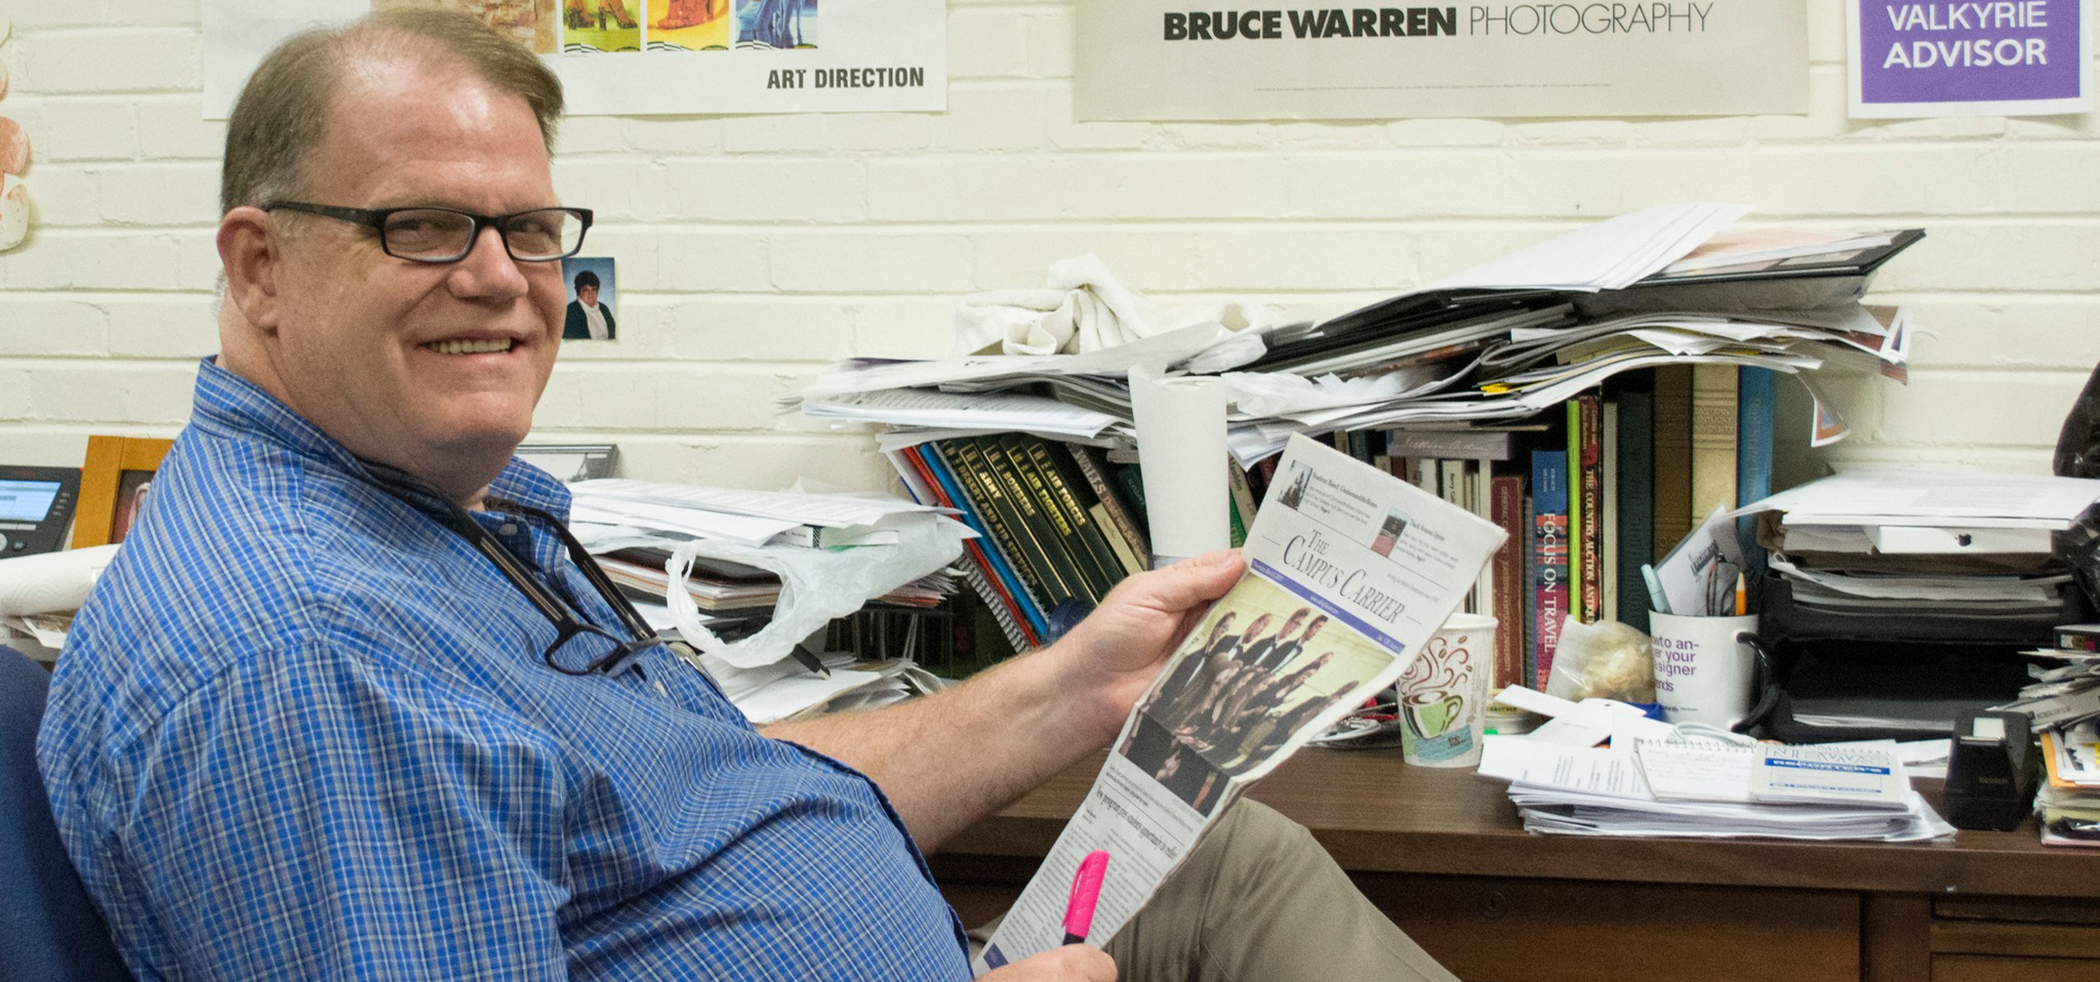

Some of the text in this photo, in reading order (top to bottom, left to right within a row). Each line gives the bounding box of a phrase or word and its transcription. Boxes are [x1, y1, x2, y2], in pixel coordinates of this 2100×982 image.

[1163, 2, 1714, 41] BRUCE WARREN PHOTOGRAPHY
[1886, 1, 2048, 31] VALKYRIE
[1883, 39, 2047, 69] ADVISOR
[766, 67, 925, 90] ART DIRECTION
[978, 469, 1002, 500] ARMY
[1073, 449, 1107, 494] WALLS
[1585, 469, 1594, 488] THE
[1001, 470, 1035, 516] BOMBERS
[1026, 470, 1072, 536] AIR FIGHTERS
[1045, 468, 1086, 526] AIR FORCES
[1585, 491, 1594, 536] COUNTRY
[1305, 529, 1330, 556] THE
[1585, 539, 1594, 580] AUCTION
[1281, 533, 1344, 590] CAMPUS
[1340, 568, 1406, 625] CARRIER
[1543, 513, 1556, 651] FOCUS ON TRAVEL
[1665, 651, 1695, 662] your
[1676, 639, 1699, 649] an-
